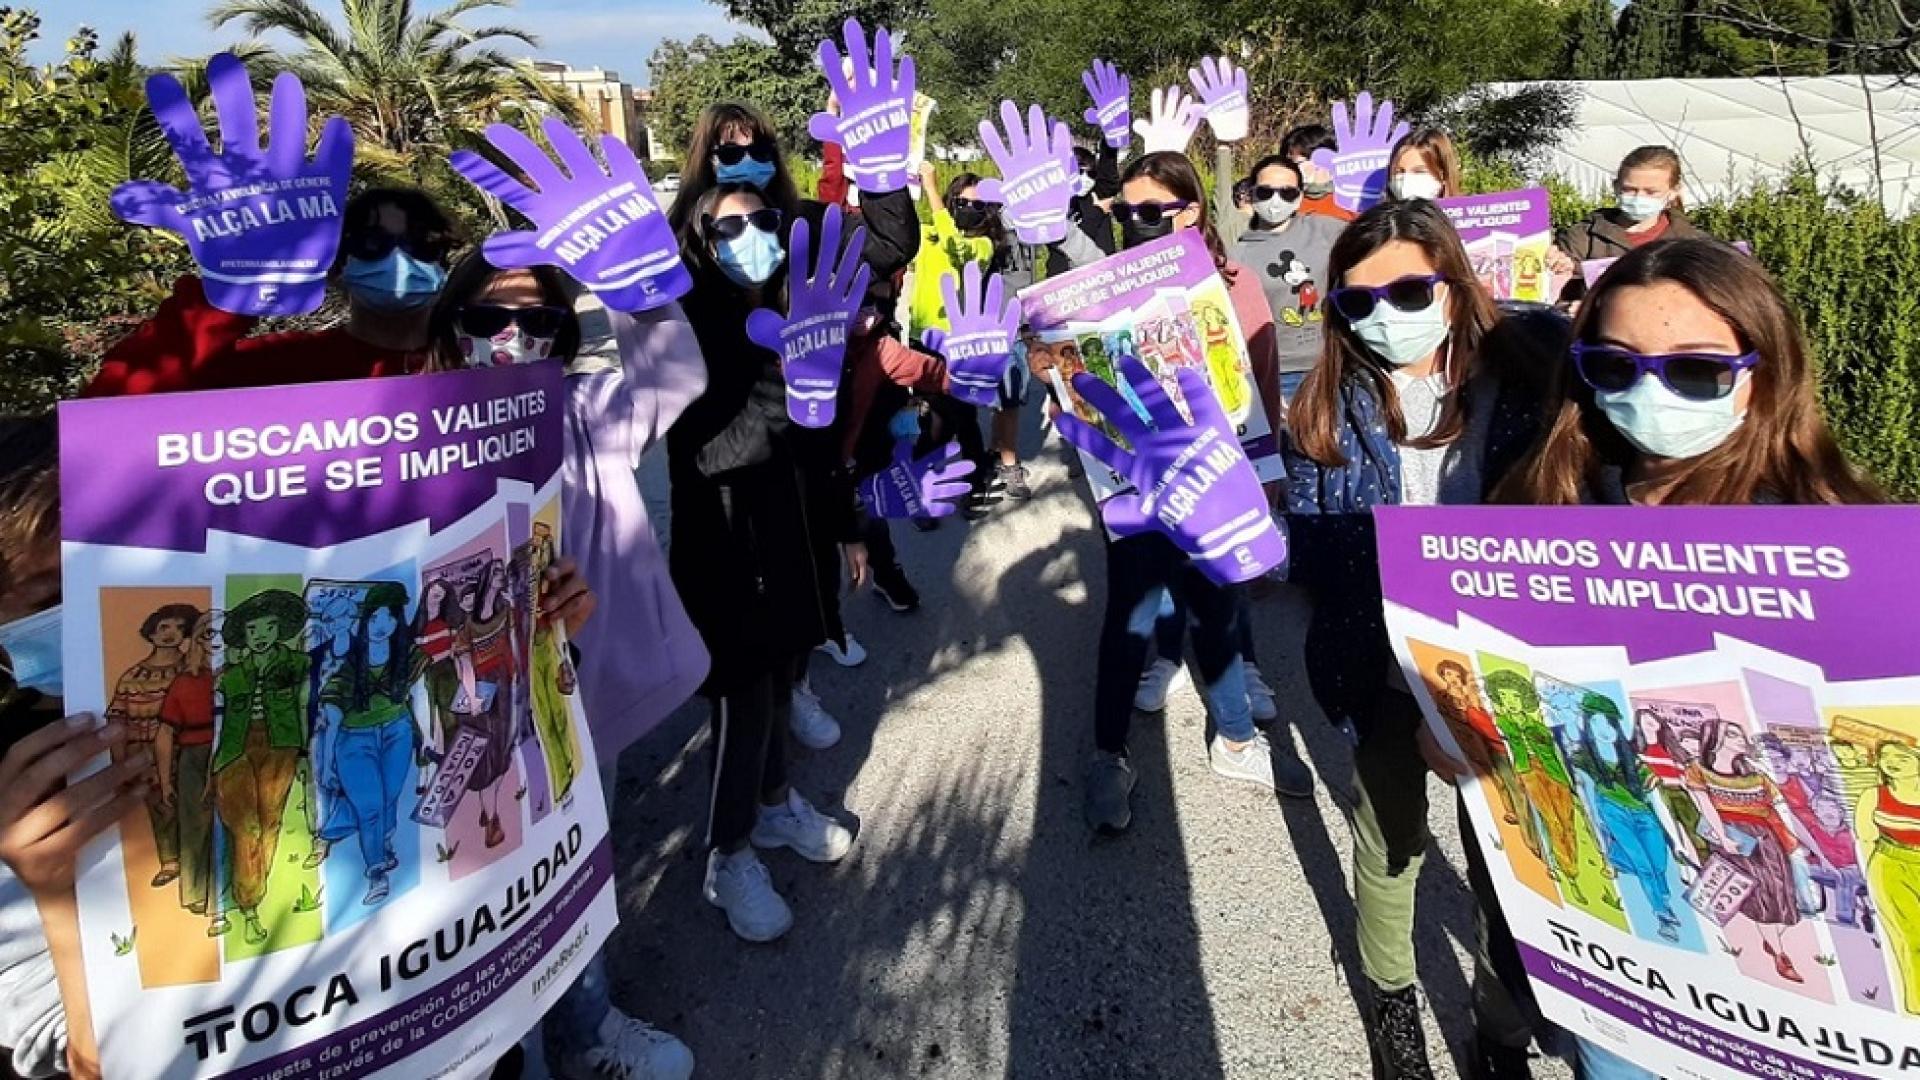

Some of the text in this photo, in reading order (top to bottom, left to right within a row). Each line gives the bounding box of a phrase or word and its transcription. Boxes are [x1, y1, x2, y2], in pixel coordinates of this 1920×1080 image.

[192, 190, 338, 243] ALÇA LA MÀ
[555, 224, 607, 266] ALÇA
[595, 209, 630, 234] LA
[618, 192, 657, 221] MÀ
[1043, 244, 1186, 306] BUSCAMOS VALIENTES
[1061, 262, 1181, 314] QUE SE IMPLIQUEN
[814, 328, 828, 350] LA
[157, 389, 546, 468] BUSCAMOS VALIENTES
[203, 425, 535, 506] QUE SE IMPLIQUEN
[1158, 484, 1200, 531] ALÇA
[1185, 465, 1218, 494] LA
[1204, 440, 1244, 476] MÀ
[1420, 534, 1850, 580] BUSCAMOS VALIENTES
[1449, 569, 1816, 621] QUE SE IMPLIQUEN
[319, 1044, 343, 1063] de
[349, 994, 445, 1054] prevención
[450, 979, 471, 999] de
[475, 962, 497, 984] las
[1549, 960, 1579, 982] Una
[1652, 1009, 1673, 1026] de
[318, 1048, 374, 1080] través
[381, 1036, 403, 1055] de
[409, 1026, 424, 1042] la
